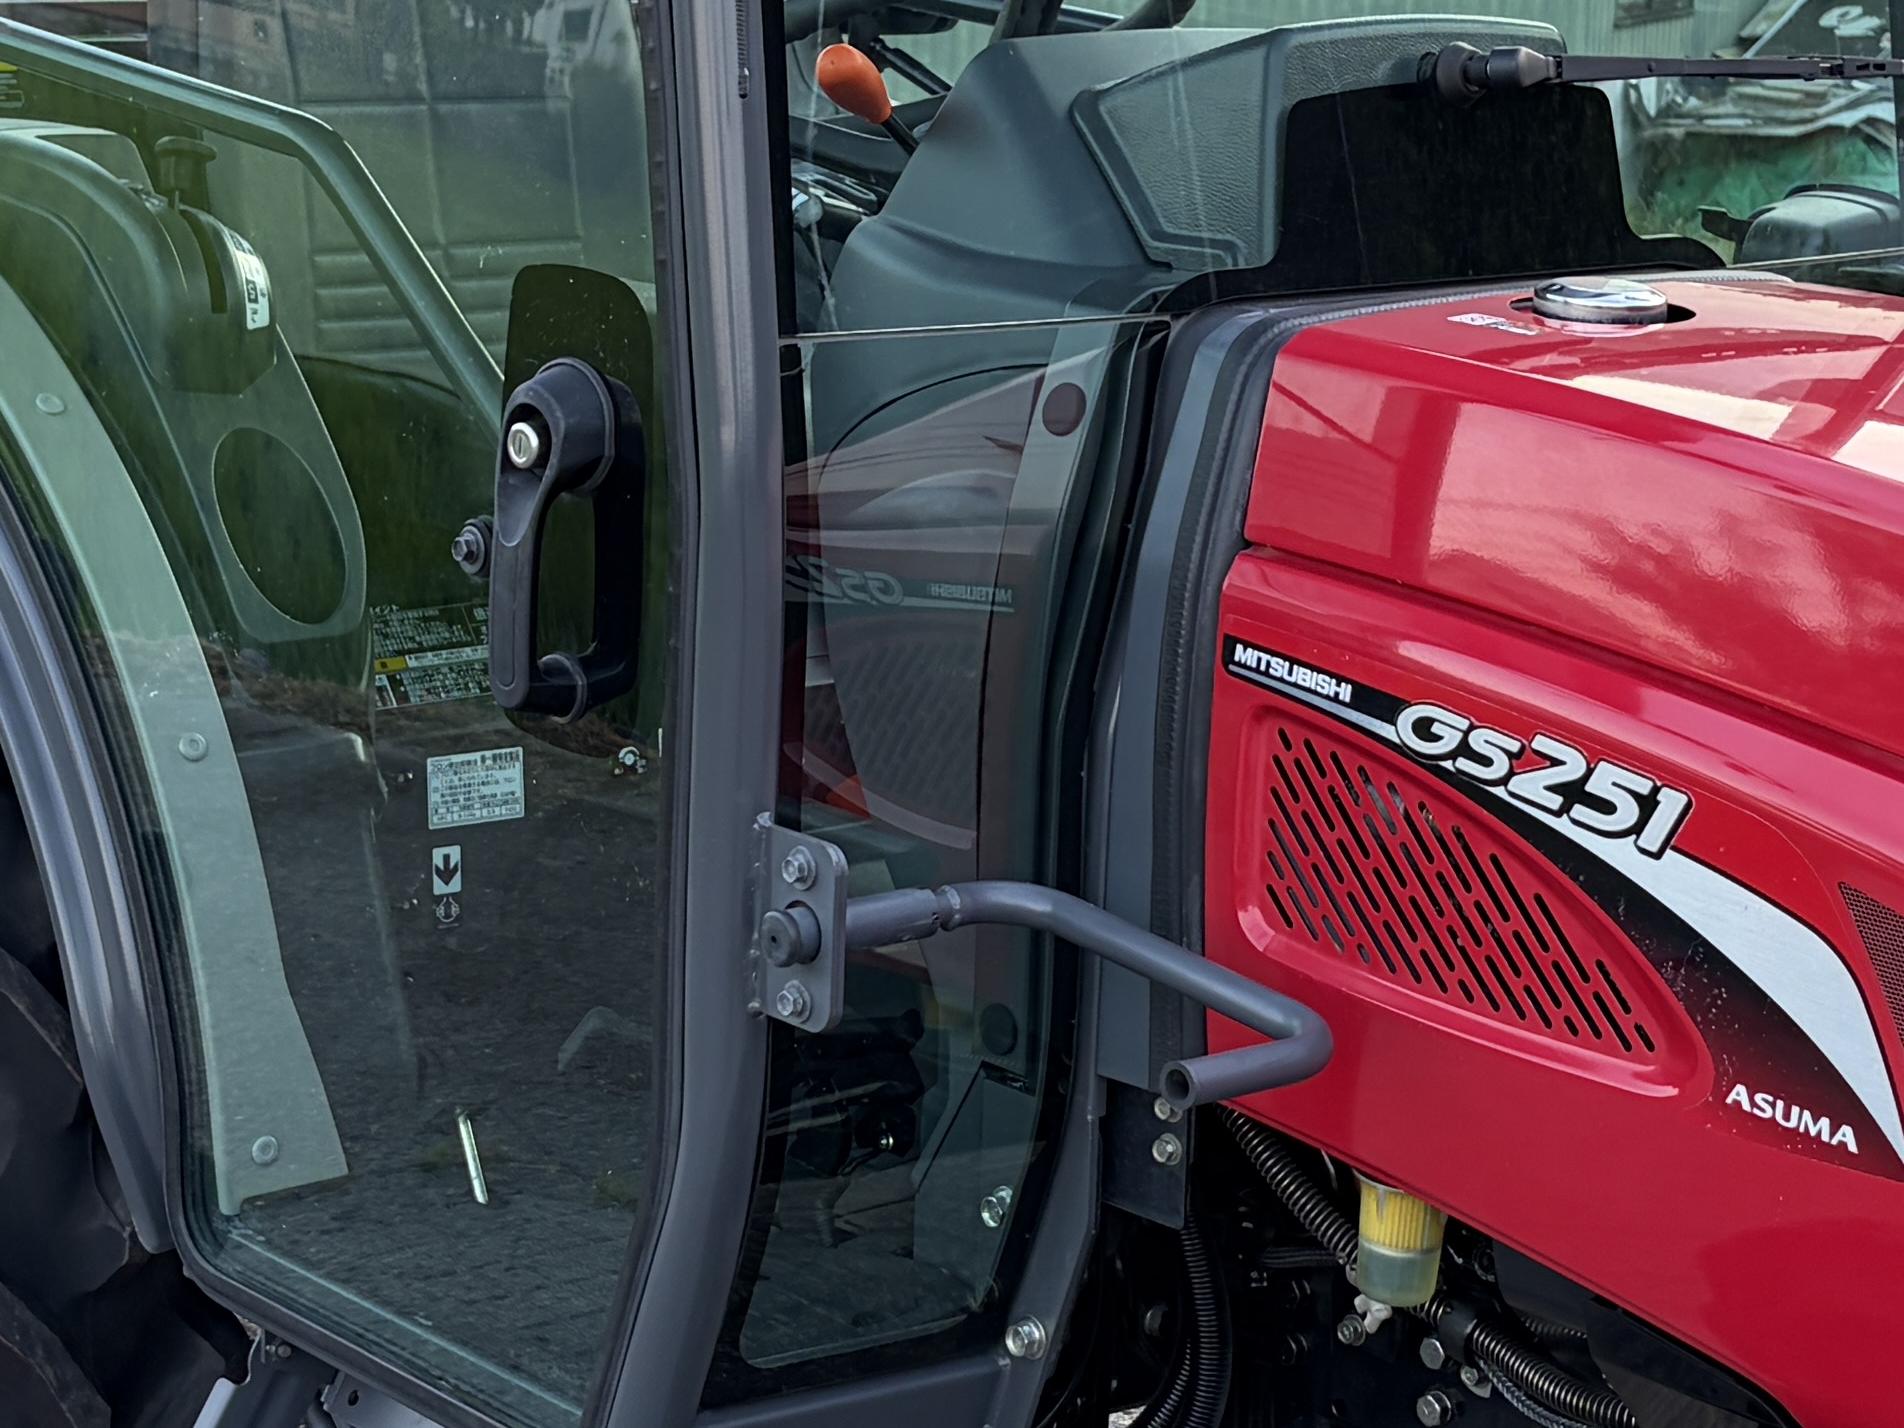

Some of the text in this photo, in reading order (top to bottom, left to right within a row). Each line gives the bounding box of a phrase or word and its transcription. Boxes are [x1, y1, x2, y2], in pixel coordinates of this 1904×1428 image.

[1233, 642, 1353, 703] MITSUBISHI
[1394, 702, 1692, 858] GS251
[1724, 1082, 1860, 1155] ASUMA
